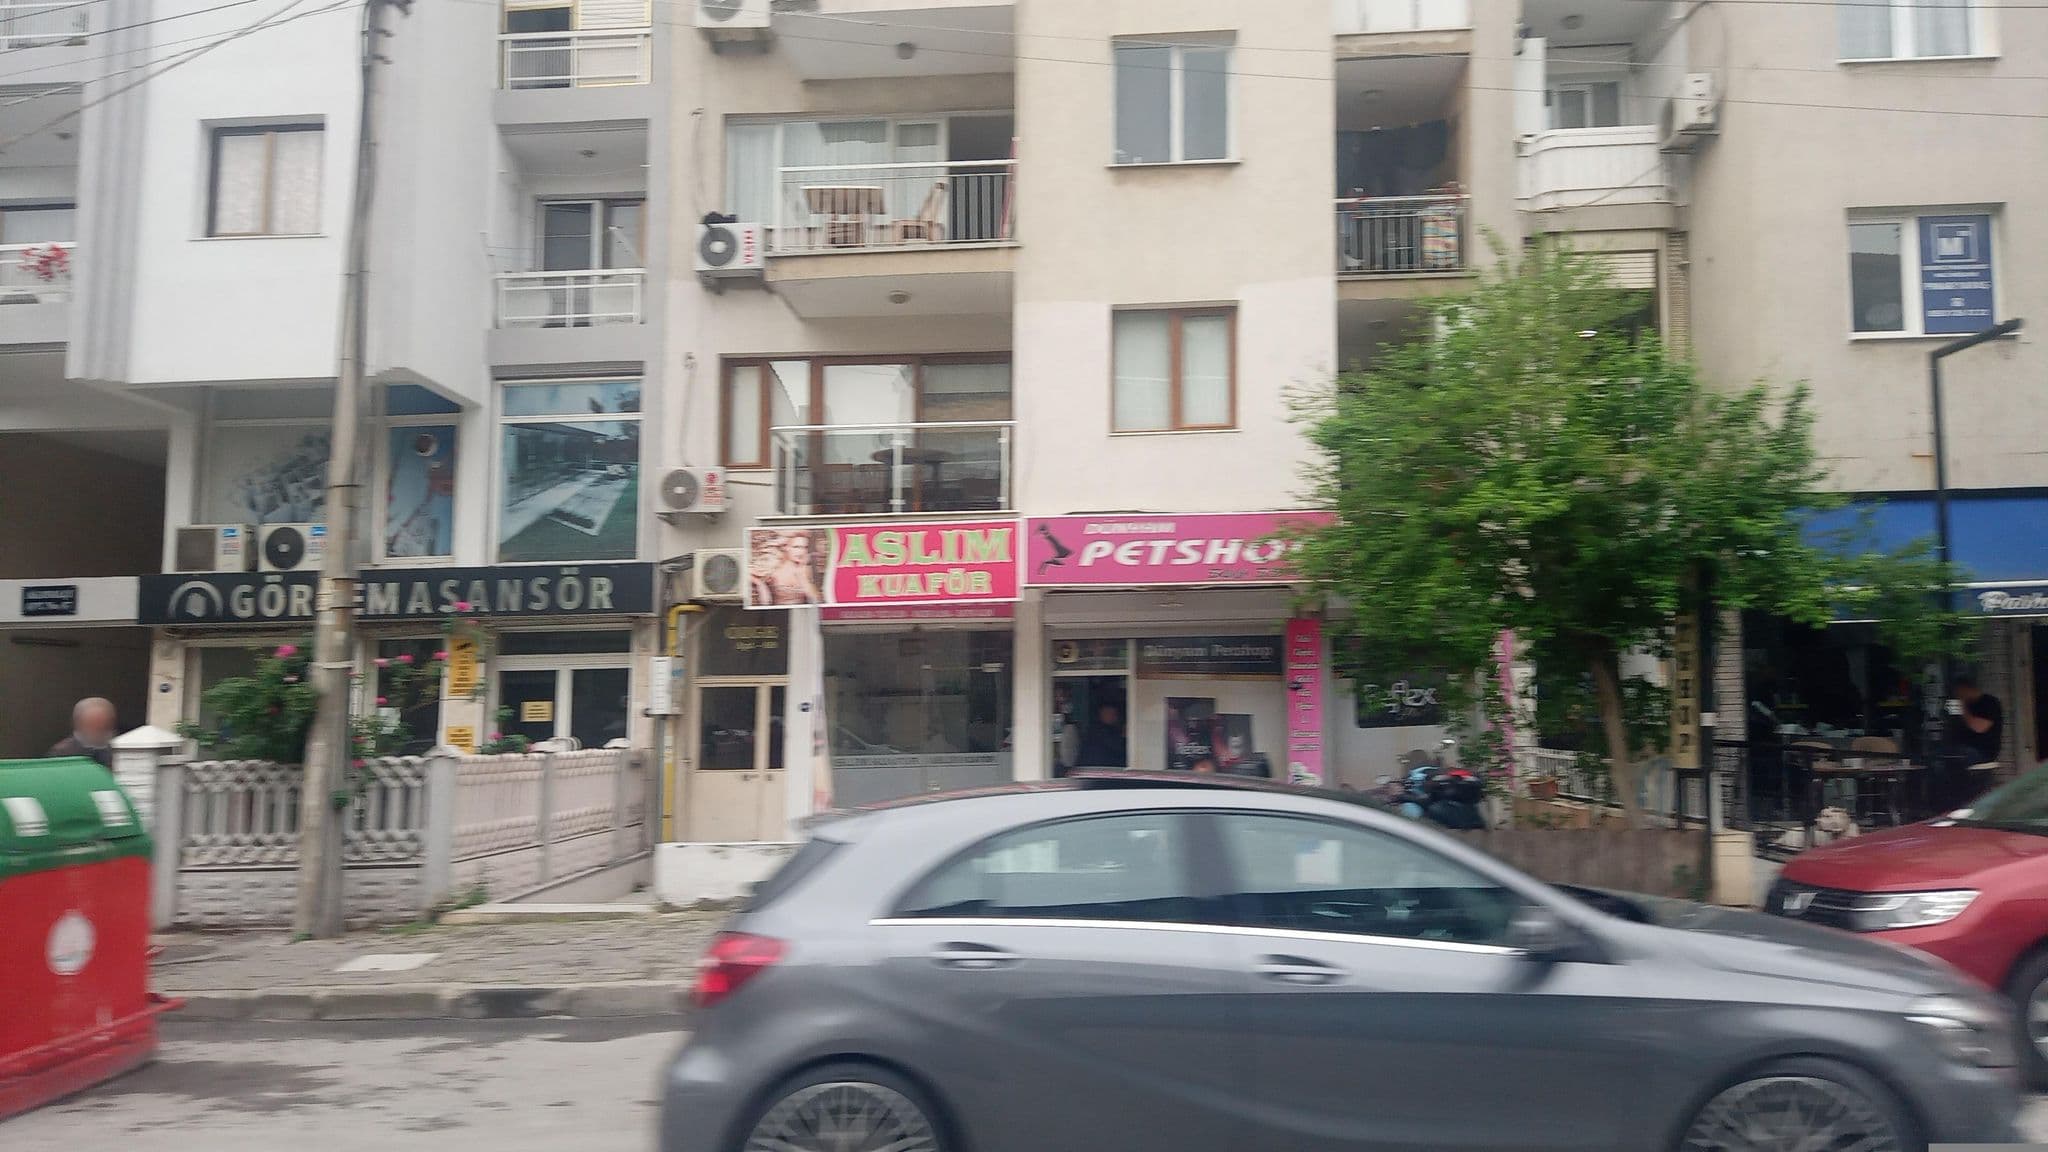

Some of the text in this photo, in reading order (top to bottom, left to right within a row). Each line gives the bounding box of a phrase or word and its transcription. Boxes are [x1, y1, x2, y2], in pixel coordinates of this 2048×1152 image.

[836, 527, 1013, 568] ASLIM
[1078, 538, 1305, 567] PETSHO
[856, 568, 993, 597] KUAFÖR
